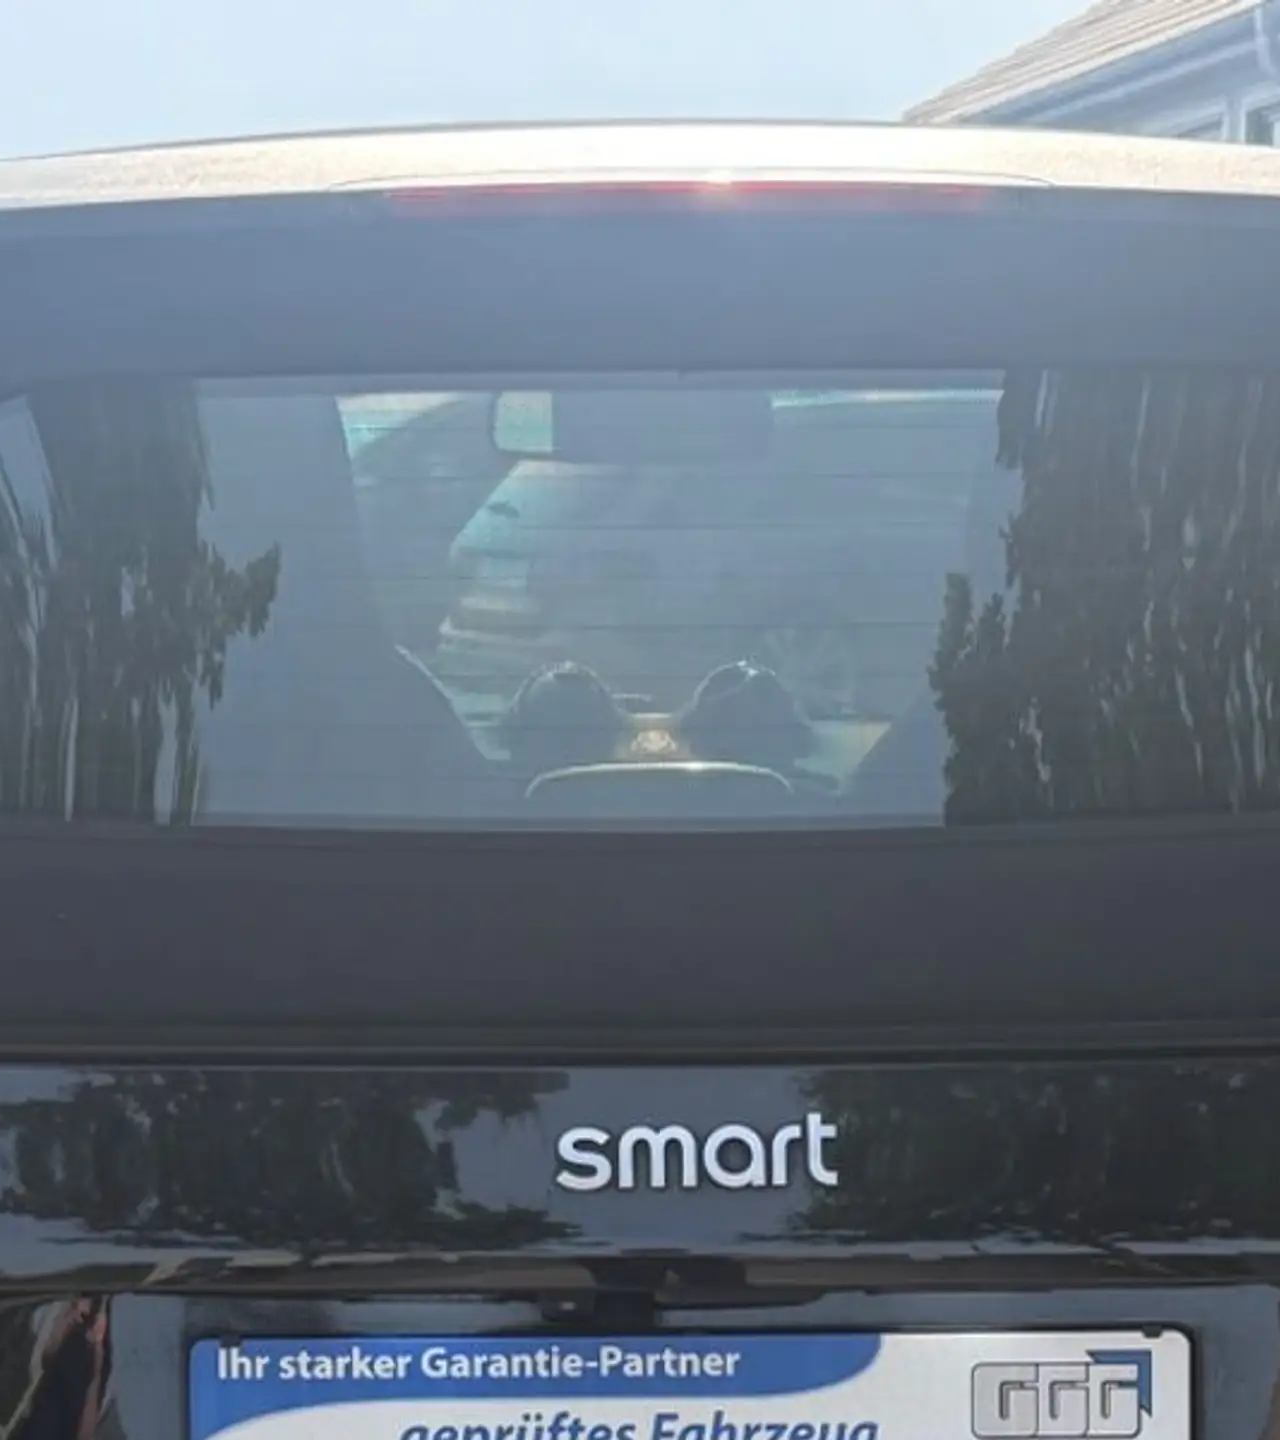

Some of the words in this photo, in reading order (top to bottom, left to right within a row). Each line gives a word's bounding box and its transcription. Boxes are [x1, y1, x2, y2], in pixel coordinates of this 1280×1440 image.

[556, 1112, 839, 1190] smart
[218, 1347, 269, 1379] Ihr
[279, 1346, 411, 1380] starker
[421, 1346, 740, 1379] Garantie-Partner
